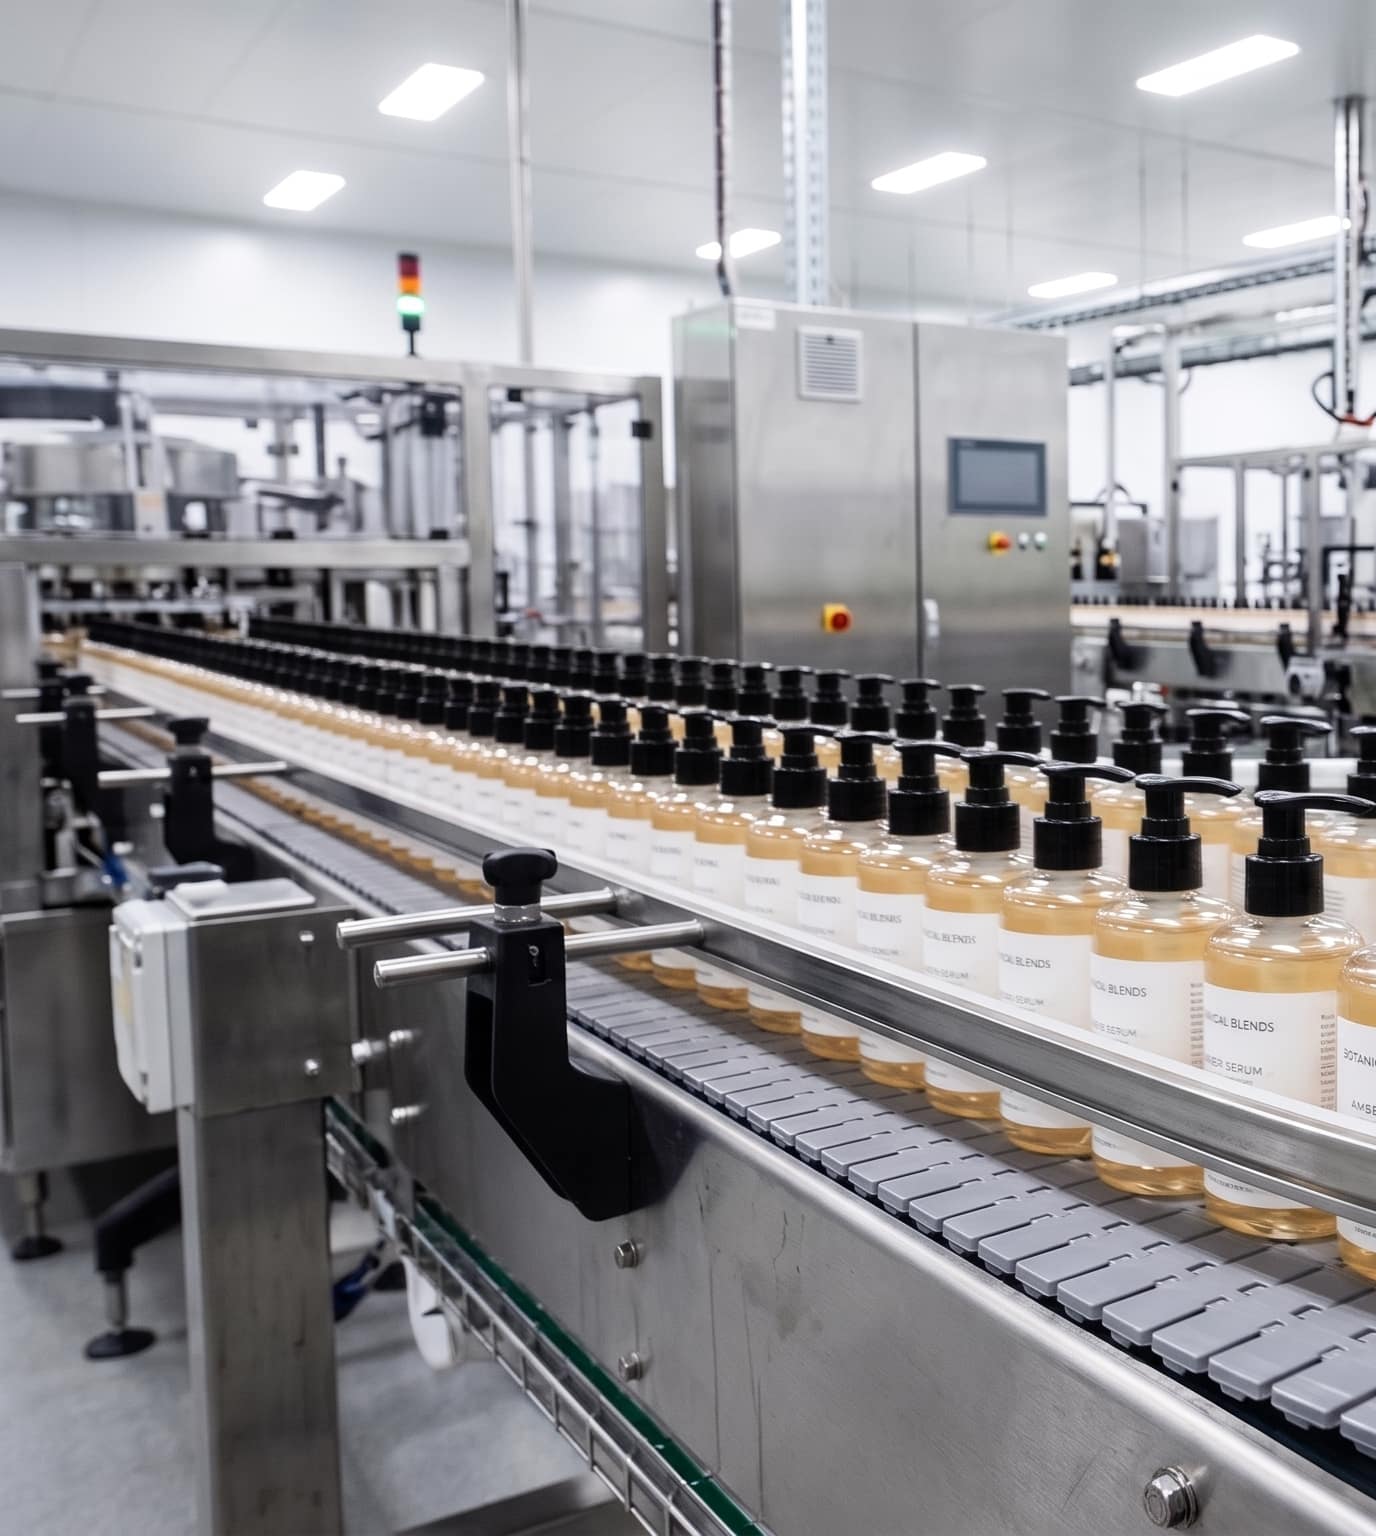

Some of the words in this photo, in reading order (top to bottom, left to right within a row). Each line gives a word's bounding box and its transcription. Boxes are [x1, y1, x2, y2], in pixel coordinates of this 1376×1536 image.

[1108, 983, 1148, 997] BLENDS
[1106, 1024, 1137, 1037] SERUM
[1230, 1018, 1275, 1032] BLENDS
[1225, 1062, 1263, 1076] SERUM
